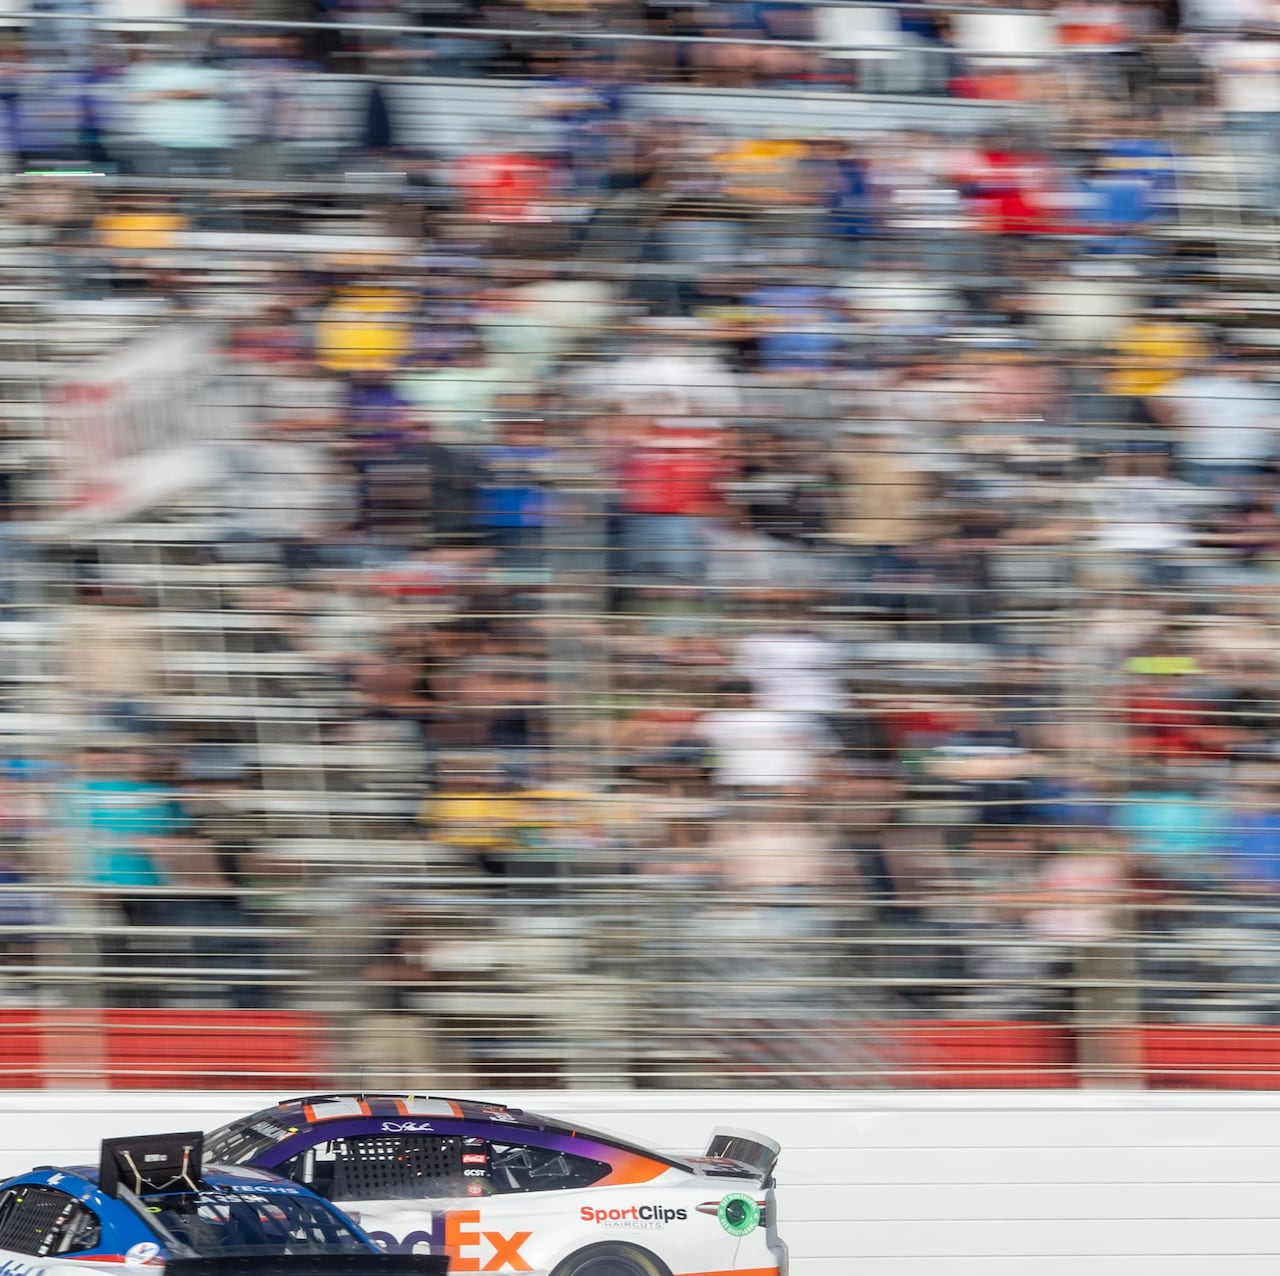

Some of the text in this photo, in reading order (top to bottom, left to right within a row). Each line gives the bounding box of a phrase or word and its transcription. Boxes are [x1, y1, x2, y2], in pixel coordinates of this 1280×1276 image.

[234, 1185, 300, 1195] TECHS
[580, 1205, 688, 1224] SportClips
[604, 1221, 663, 1229] HAIRCUTS
[366, 1210, 534, 1272] edEx
